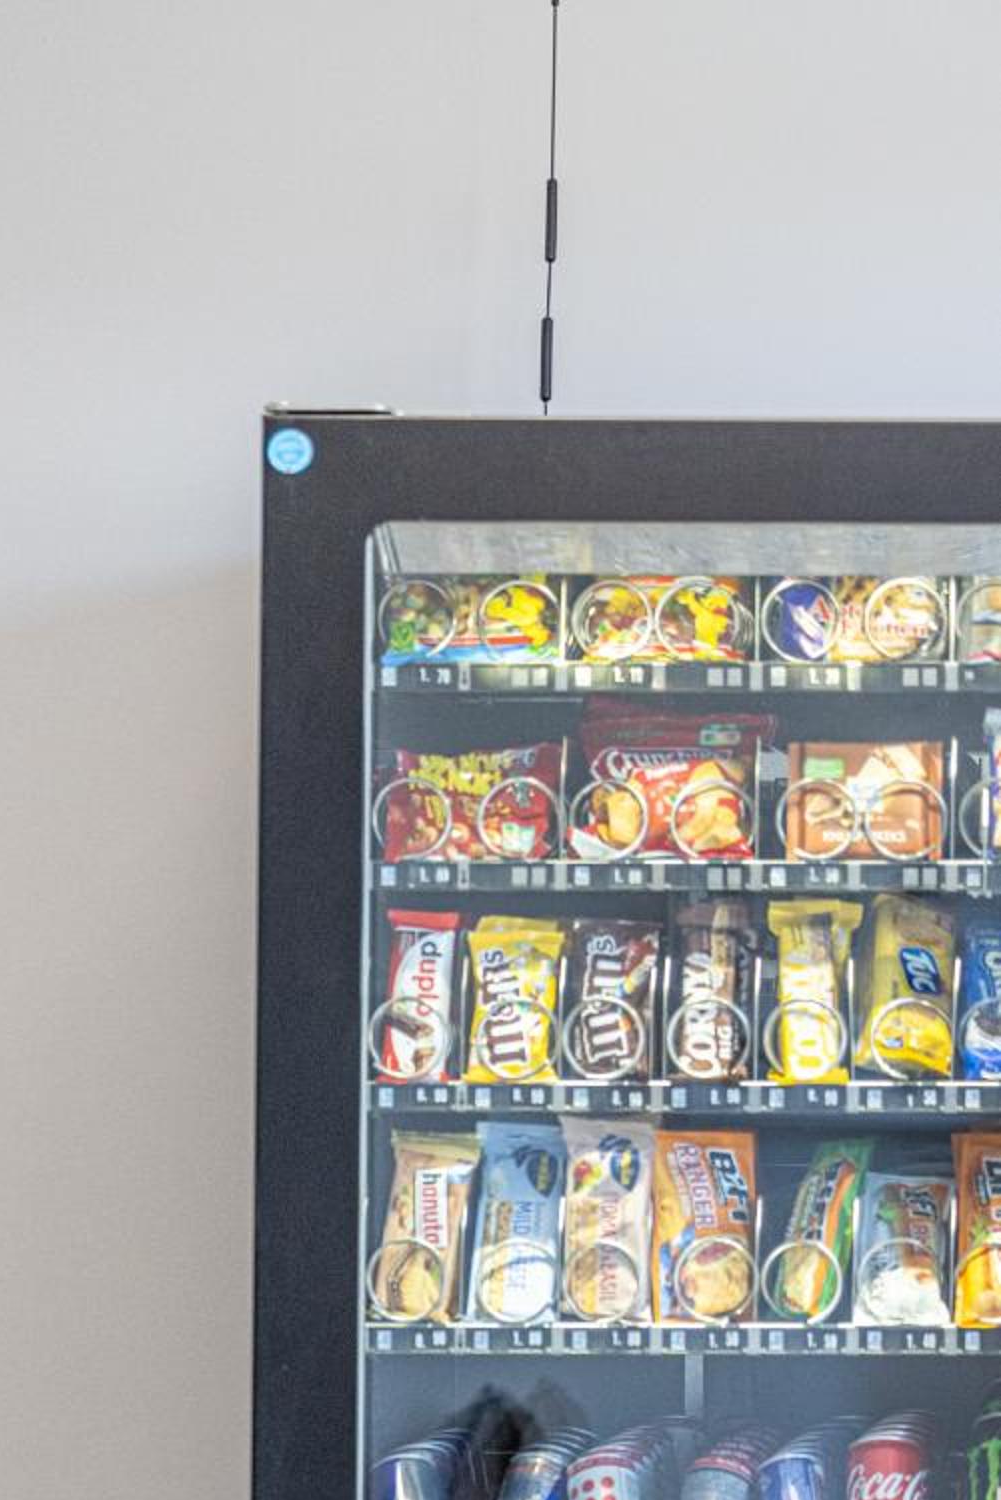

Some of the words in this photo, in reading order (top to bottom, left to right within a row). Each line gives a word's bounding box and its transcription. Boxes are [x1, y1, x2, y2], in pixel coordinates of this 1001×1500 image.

[412, 941, 442, 1018] duplo
[902, 950, 940, 993] TUC
[421, 1173, 443, 1245] hanuta
[675, 1143, 717, 1229] RANGER
